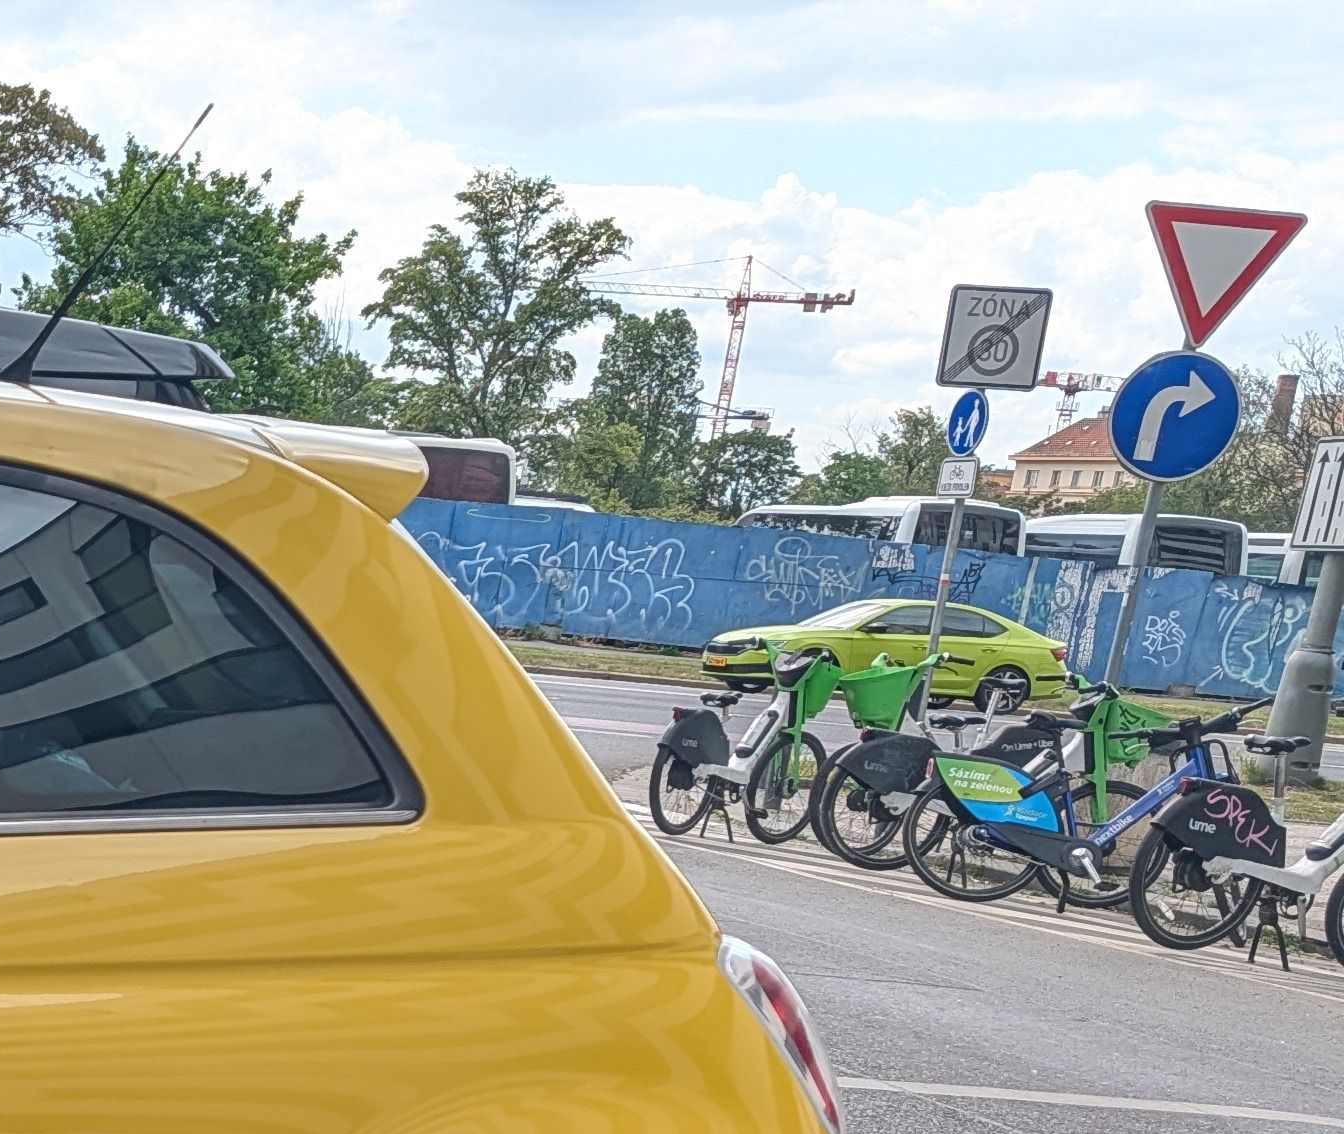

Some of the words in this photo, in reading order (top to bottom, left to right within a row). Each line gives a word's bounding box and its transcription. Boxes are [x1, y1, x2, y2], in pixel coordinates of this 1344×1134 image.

[967, 293, 1031, 319] ZÓNA
[954, 779, 968, 788] na
[970, 781, 1013, 795] zelenou
[1094, 815, 1133, 847] nextbike
[1189, 817, 1217, 834] Lime
